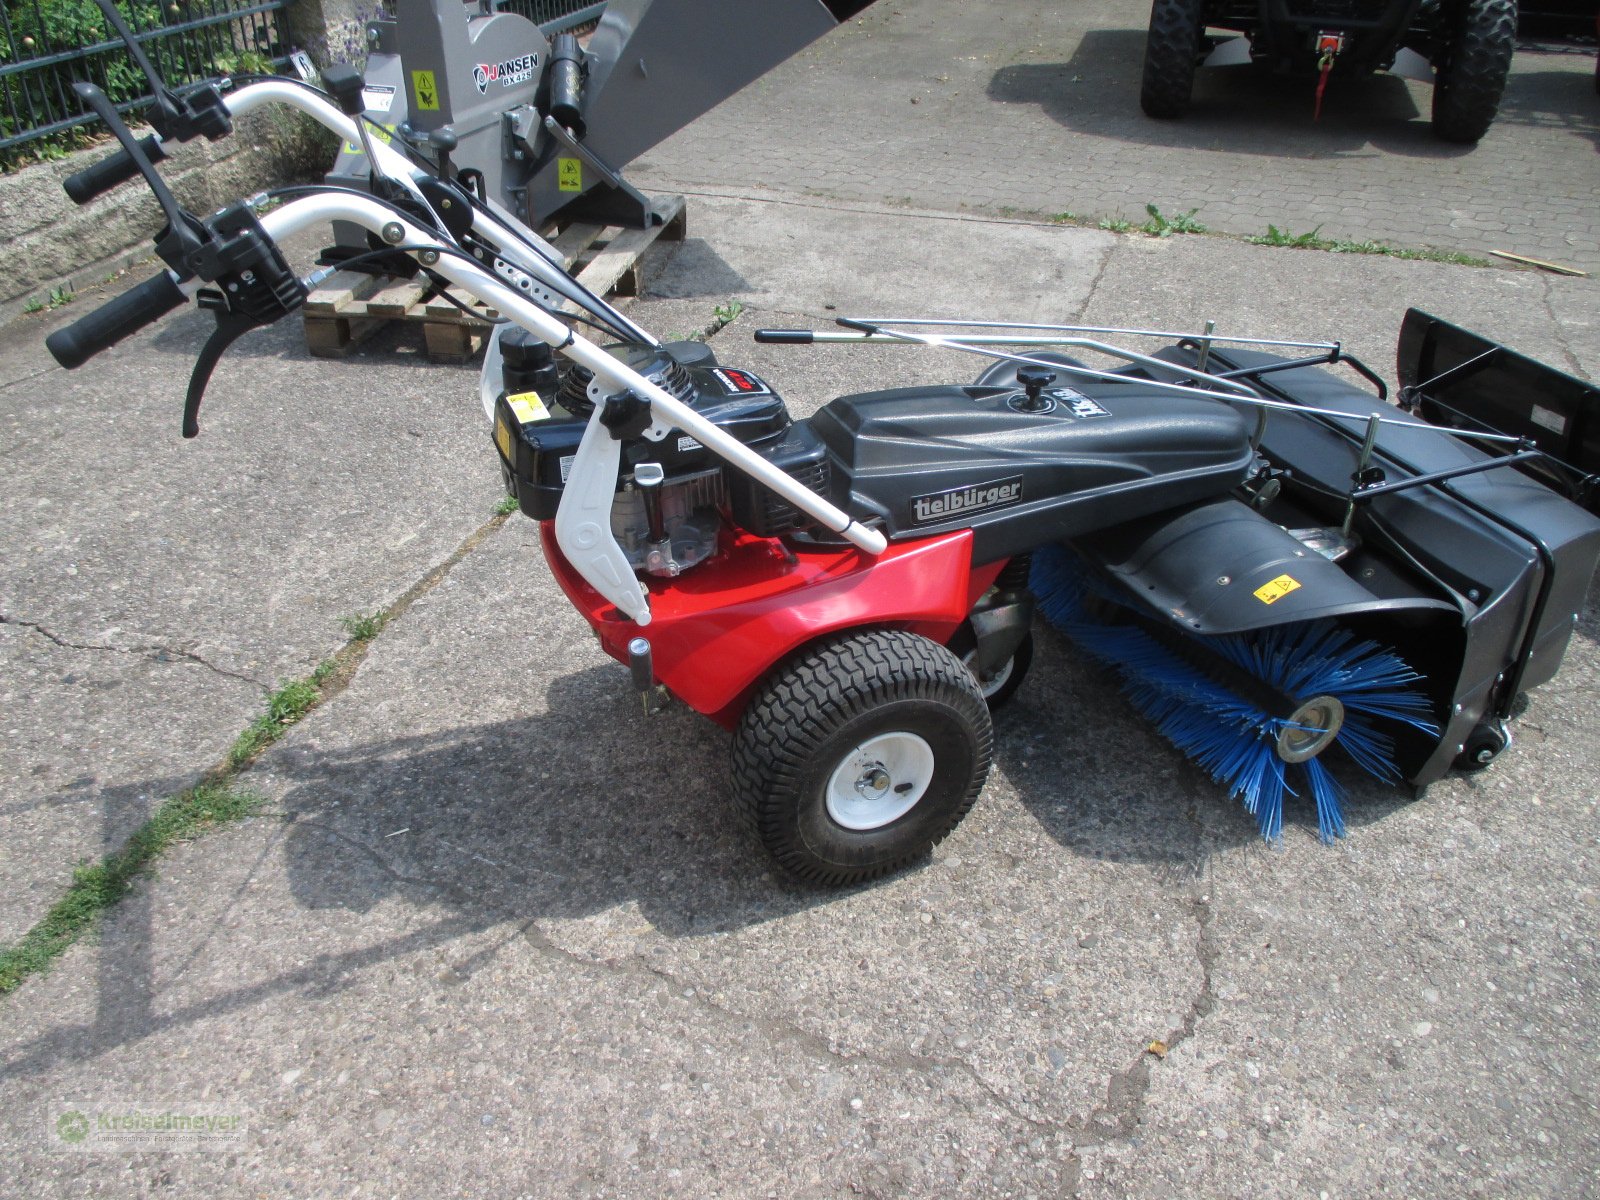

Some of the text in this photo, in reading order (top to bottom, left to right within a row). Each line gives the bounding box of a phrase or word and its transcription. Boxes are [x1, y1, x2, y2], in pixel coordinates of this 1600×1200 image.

[490, 53, 538, 81] JANSEN
[504, 76, 515, 86] BX
[914, 483, 1021, 521] tielbürger
